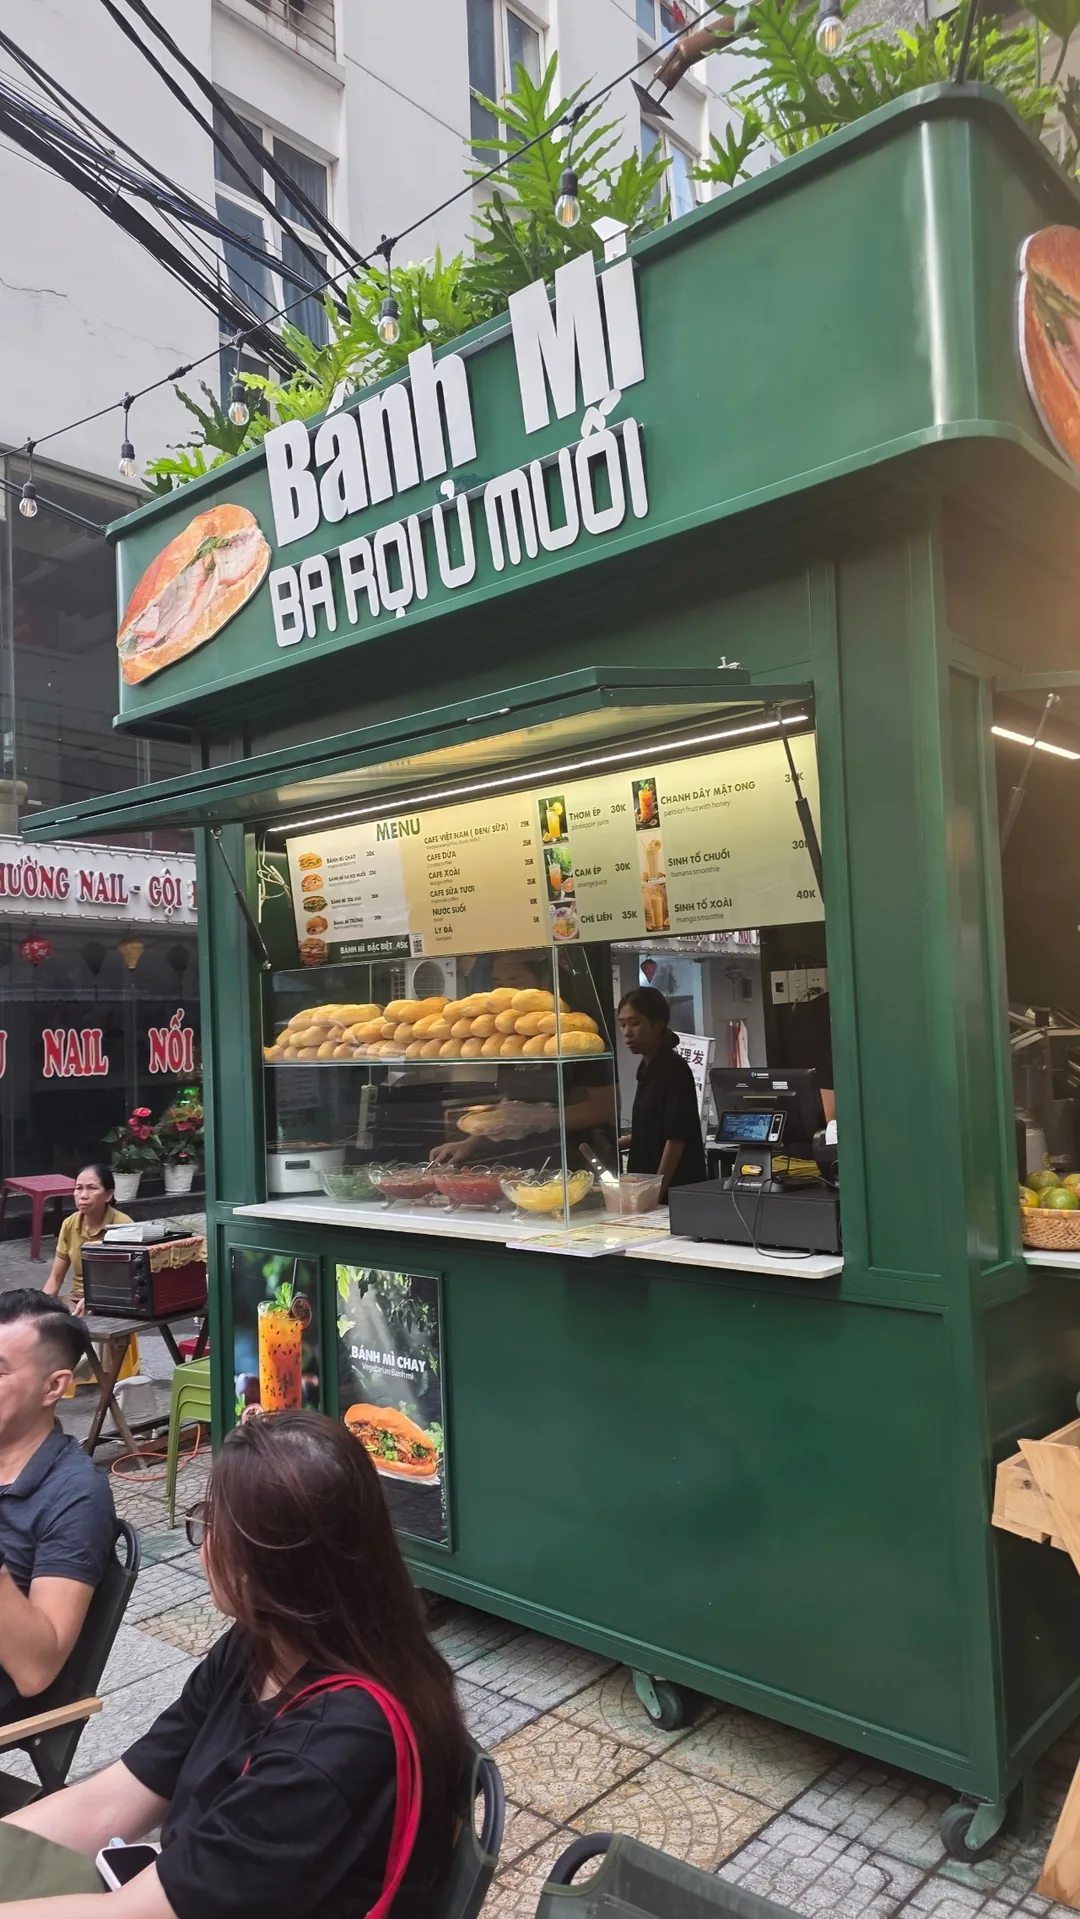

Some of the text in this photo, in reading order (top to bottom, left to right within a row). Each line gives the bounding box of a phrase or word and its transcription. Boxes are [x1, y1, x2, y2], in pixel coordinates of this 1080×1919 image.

[264, 216, 645, 547] Bánh Mì
[269, 388, 649, 648] BA RỌI Ủ MUỐI
[660, 772, 804, 805] CHANH DÂY MẬT ONG 3K
[568, 803, 627, 821] THƠM ÉP 30K
[663, 807, 686, 818] passion
[698, 802, 711, 811] with
[711, 800, 731, 809] honey
[376, 817, 421, 842] MENU
[571, 819, 610, 831] pineapple juice
[424, 835, 439, 845] CAFE
[440, 831, 453, 843] VIỆT
[454, 830, 470, 840] NAM
[426, 852, 441, 862] CAFE
[667, 856, 688, 867] SINH
[689, 850, 701, 864] TỐ
[703, 847, 731, 862] CHUỐI
[428, 870, 443, 880] CAFE
[444, 866, 461, 877] XOÀI
[574, 862, 631, 877] CAM ÉP 30K
[671, 866, 721, 878] banana smoothie
[149, 867, 183, 917] GỘI
[430, 889, 445, 898] CAFE
[674, 889, 817, 913] SINH TỐ XOÀI 40K
[432, 905, 451, 916] NƯỚC
[451, 902, 467, 914] SUỐI
[580, 910, 638, 923] CHÈ LIÊN 35K
[676, 912, 725, 925] mango smoothie
[434, 926, 442, 935] LY
[340, 944, 358, 955] BÁNH
[396, 941, 409, 949] 45K
[43, 1028, 109, 1077] NAIL
[148, 1008, 194, 1074] NỐI
[351, 1344, 427, 1373] BÁNH MÌ CHAY
[361, 1362, 391, 1374] Vegetarian
